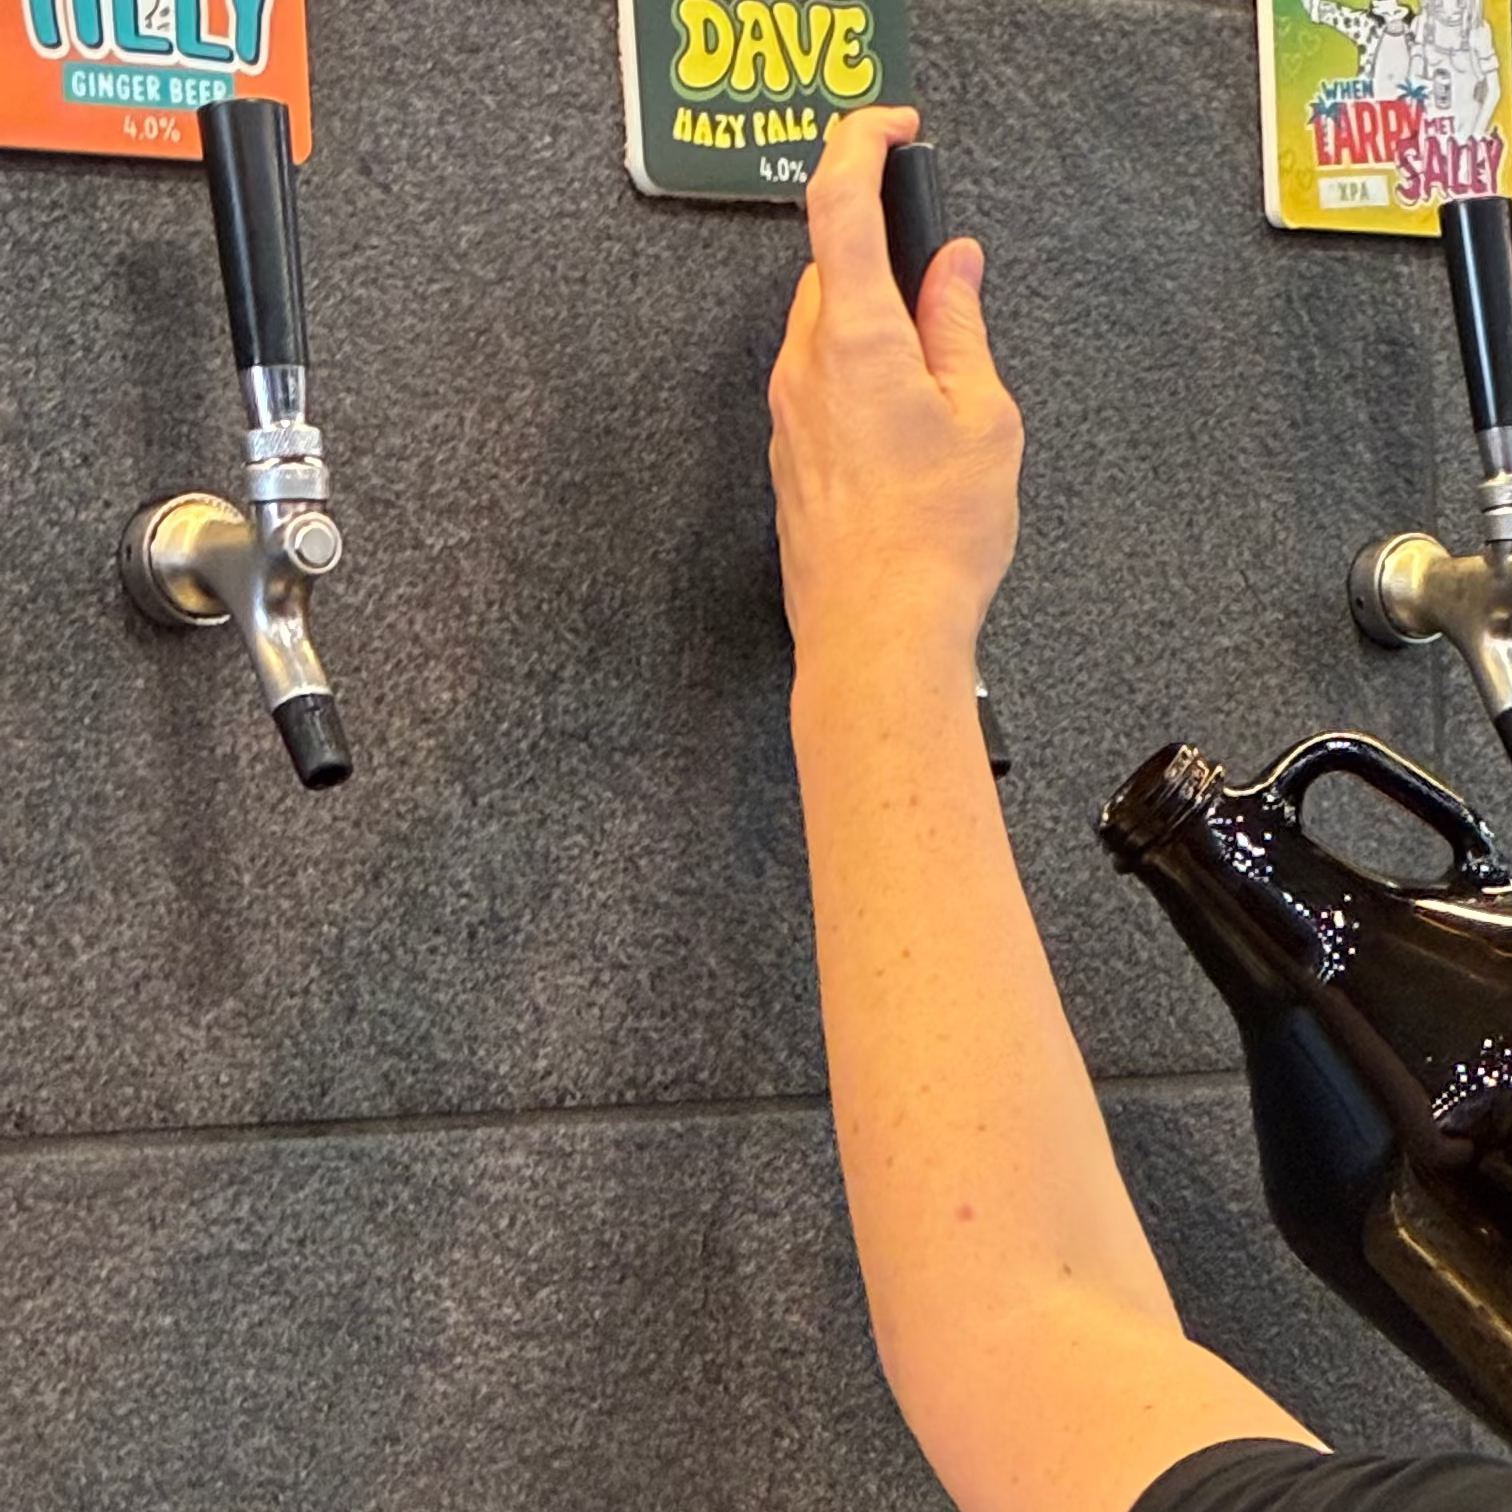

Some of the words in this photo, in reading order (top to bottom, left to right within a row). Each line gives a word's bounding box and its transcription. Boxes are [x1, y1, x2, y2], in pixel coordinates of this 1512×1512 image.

[677, 0, 874, 96] DAVE
[71, 70, 160, 101] GINGER
[169, 77, 227, 105] BEER
[1321, 79, 1374, 100] WHEN
[123, 115, 181, 142] 4.0%
[673, 106, 746, 148] HAZY
[753, 106, 818, 146] PALE
[1311, 99, 1426, 166] LARRY
[1424, 115, 1455, 135] MET
[759, 156, 808, 183] 4.0%
[1396, 130, 1503, 202] SALLY
[1338, 182, 1370, 201] XPA
